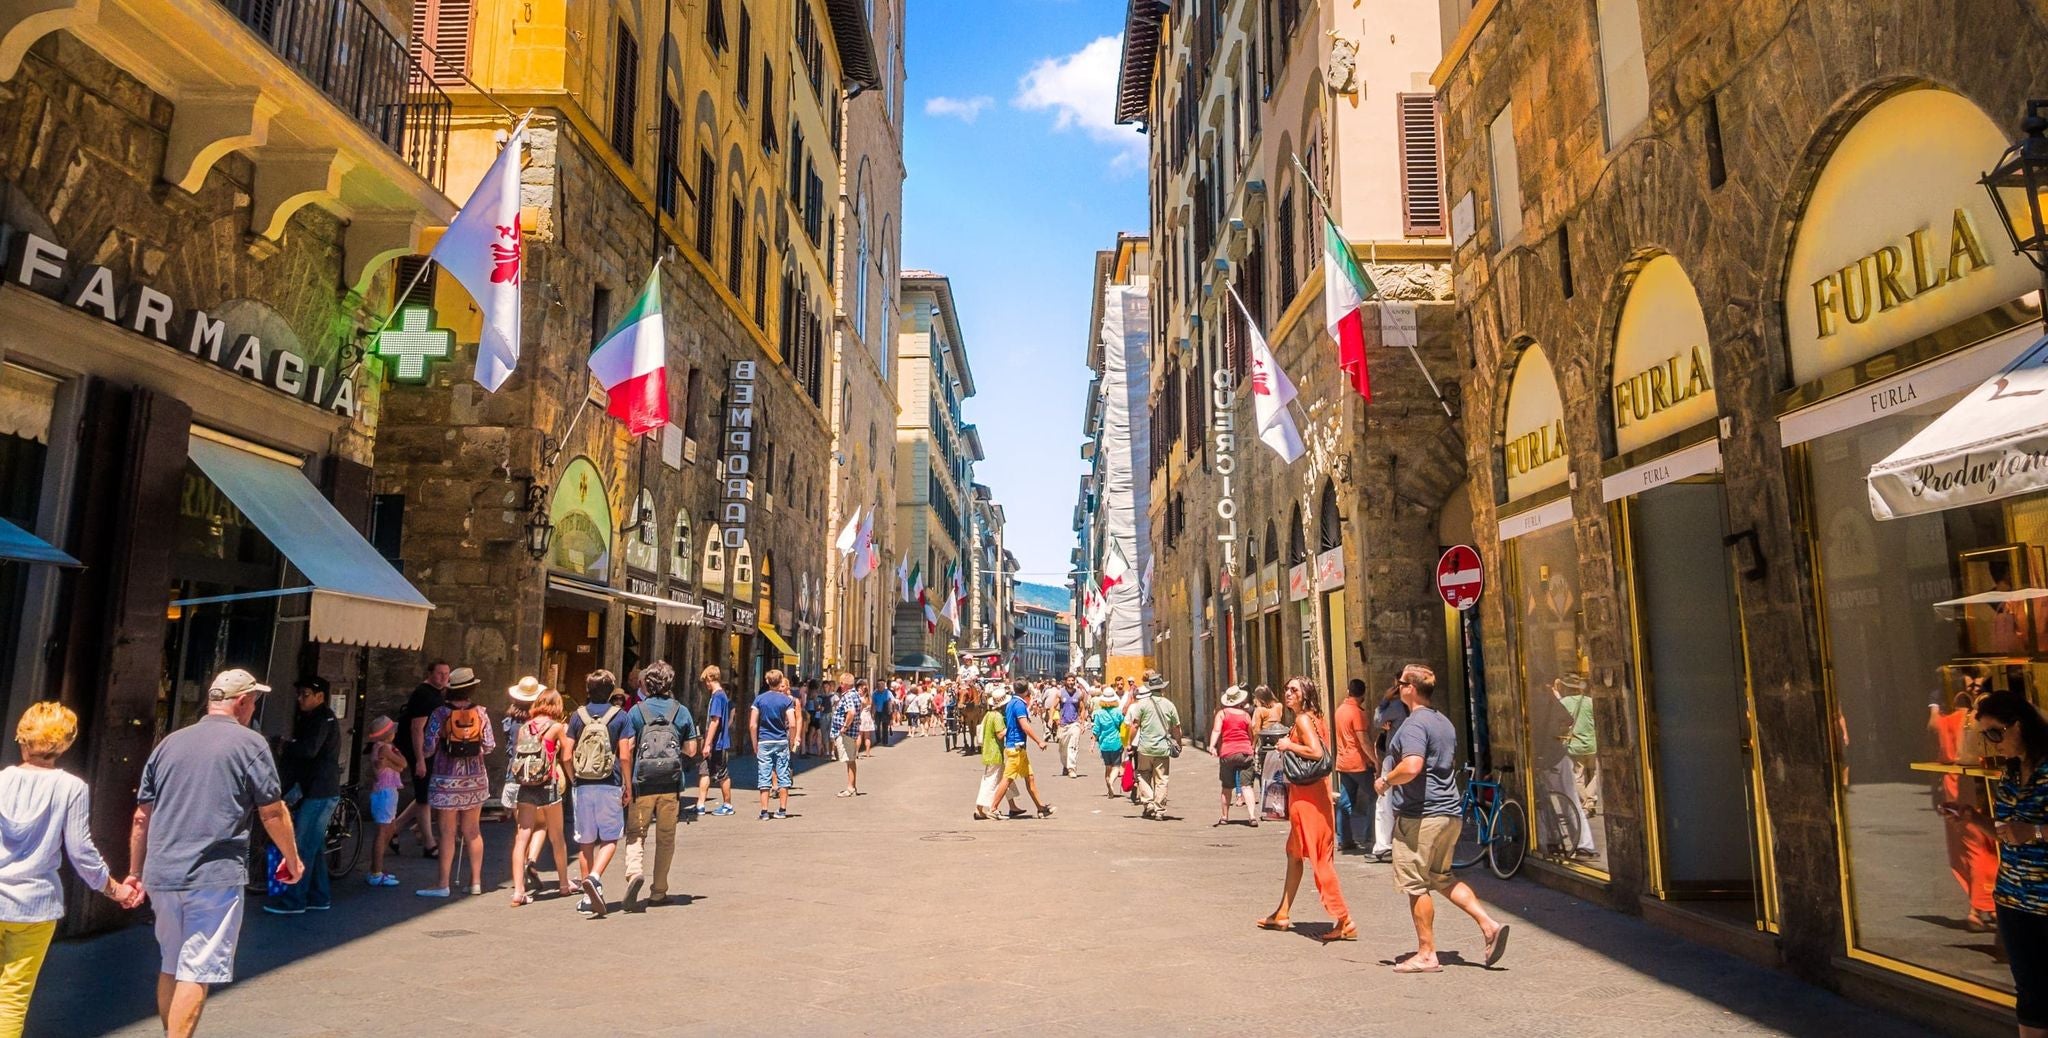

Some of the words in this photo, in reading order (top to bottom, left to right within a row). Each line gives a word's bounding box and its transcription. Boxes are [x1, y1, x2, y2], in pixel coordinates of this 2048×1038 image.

[1810, 208, 1992, 340] FURLA
[19, 233, 354, 417] FARMACIA
[1614, 345, 1713, 429] FURLA
[1870, 382, 1917, 413] FURLA
[1504, 418, 1569, 479] FURLA
[1643, 465, 1670, 486] FURLA
